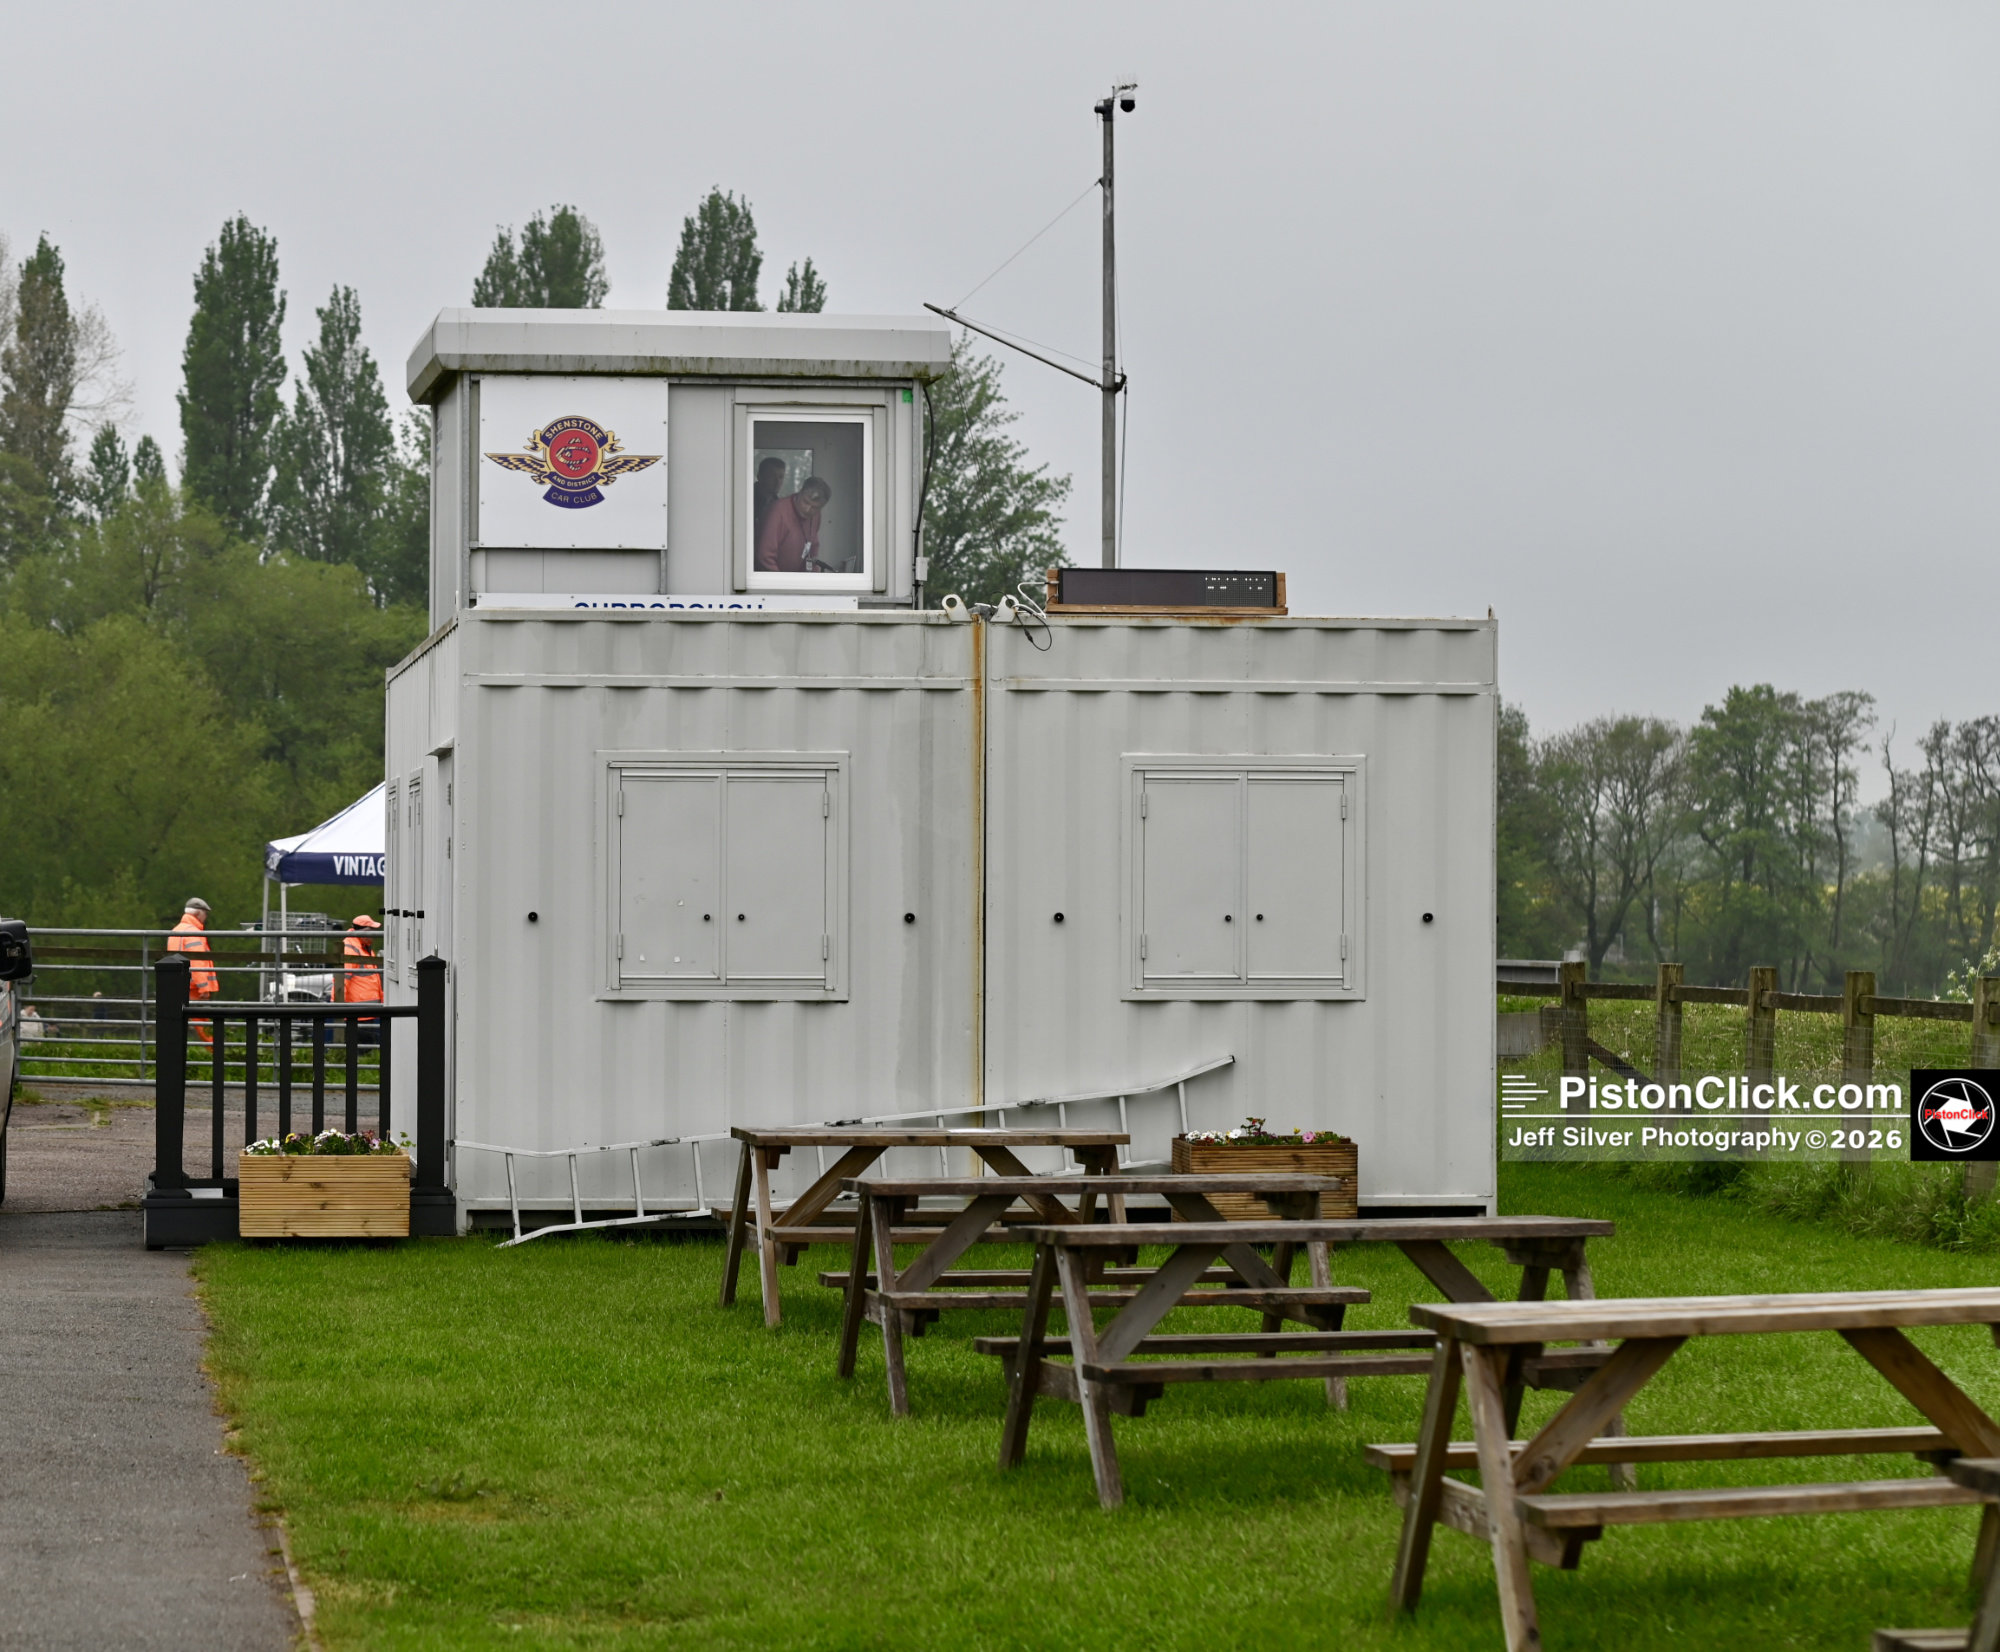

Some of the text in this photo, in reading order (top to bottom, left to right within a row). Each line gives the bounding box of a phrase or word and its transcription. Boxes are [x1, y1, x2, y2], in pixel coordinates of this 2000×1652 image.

[545, 420, 603, 439] SHENSTONE
[552, 475, 596, 487] AND DISTRICT
[551, 492, 598, 504] CAR CLUB
